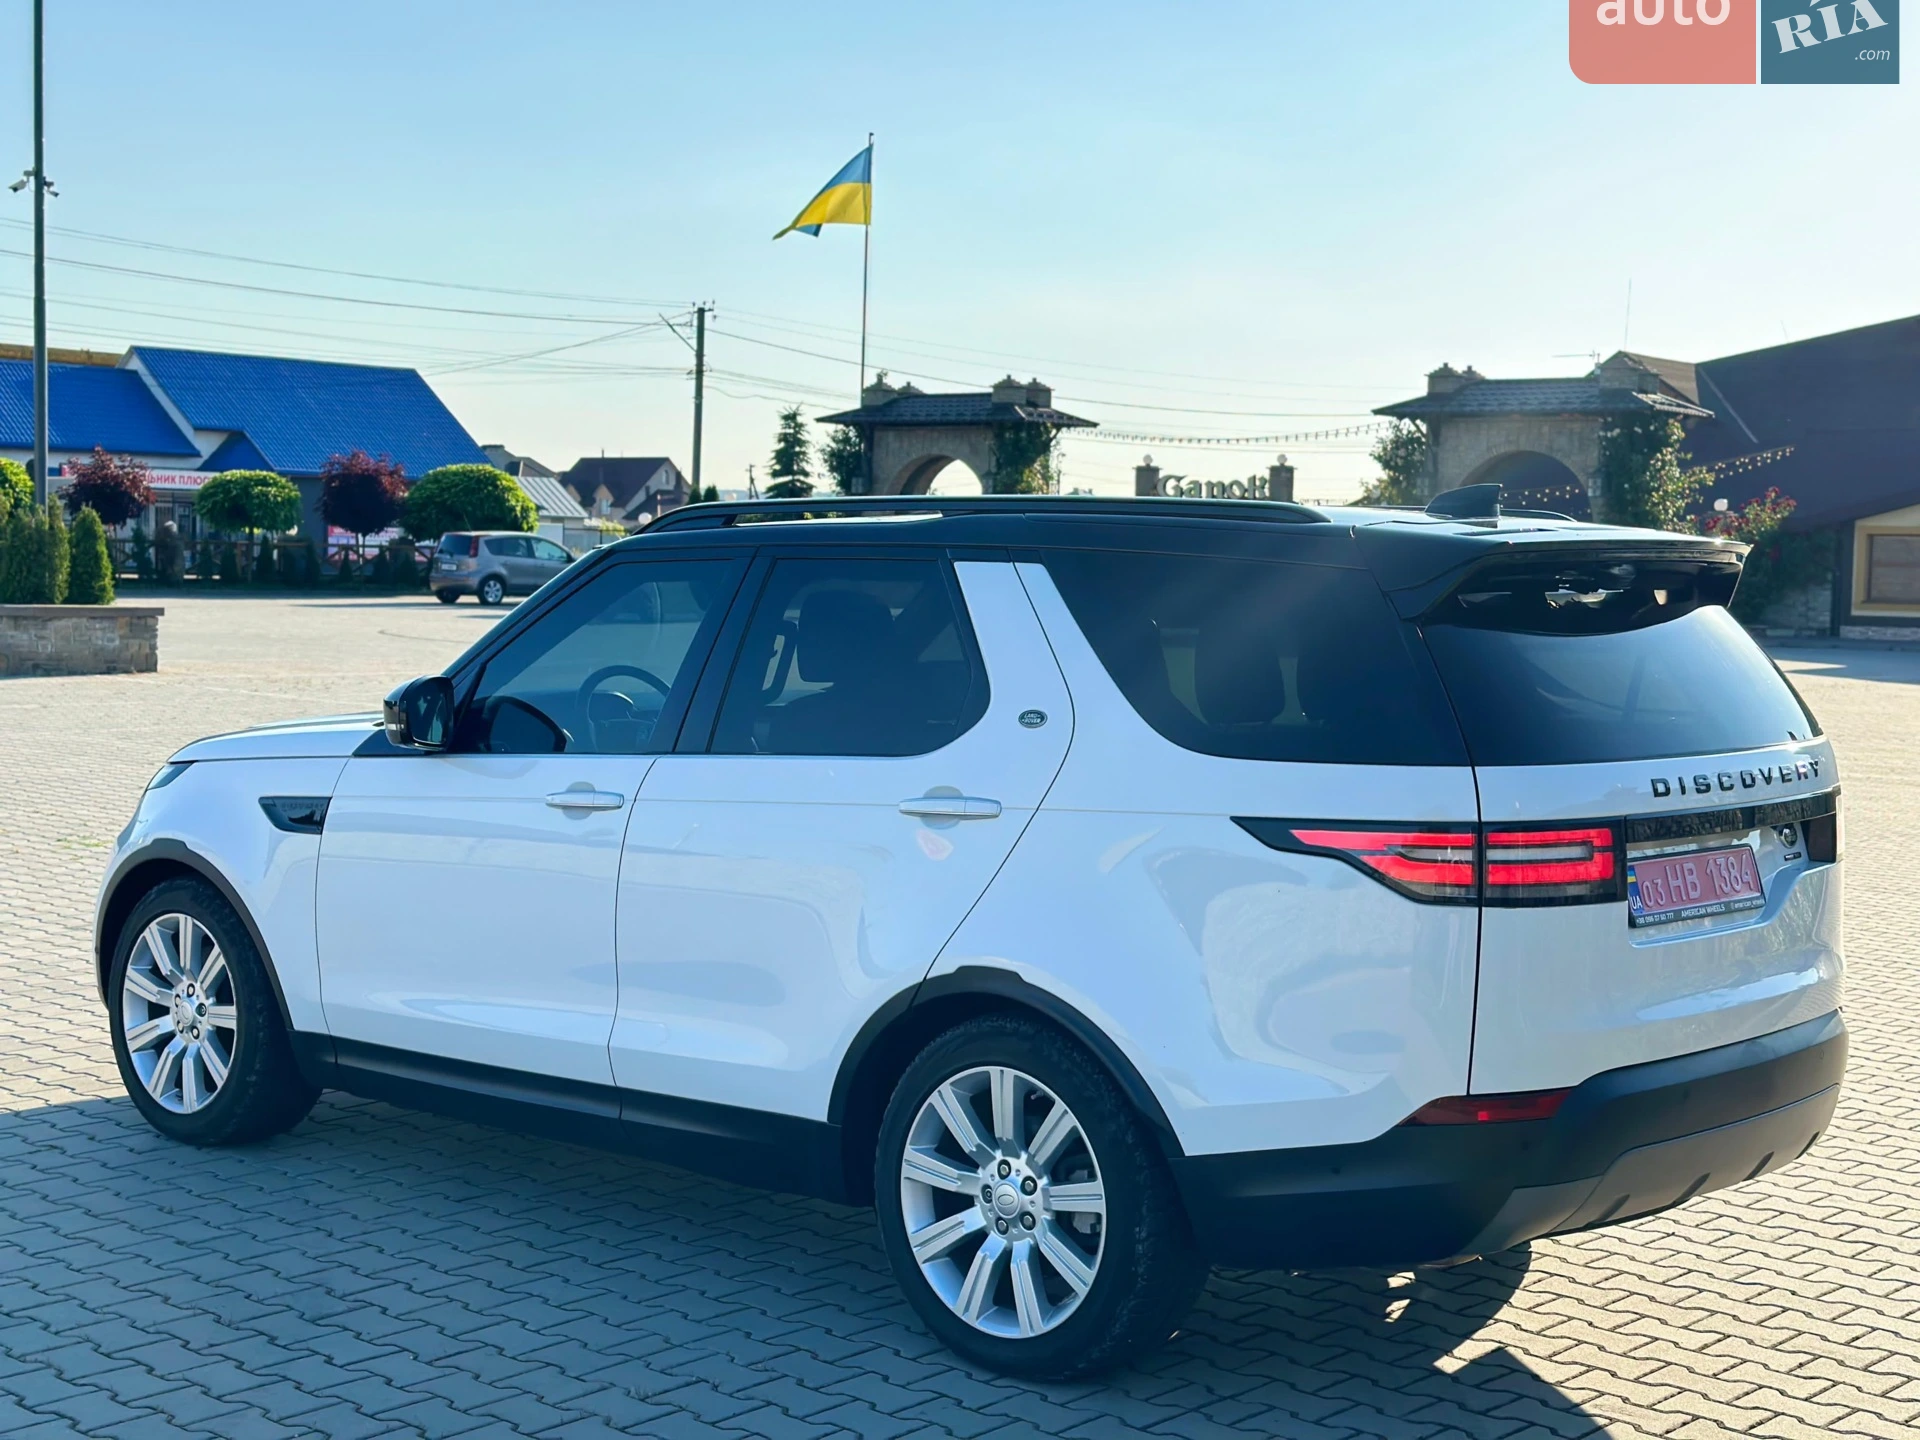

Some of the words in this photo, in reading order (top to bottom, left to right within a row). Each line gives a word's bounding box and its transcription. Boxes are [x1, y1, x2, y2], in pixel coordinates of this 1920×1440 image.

[1651, 760, 1820, 798] DISCOVERY
[1642, 878, 1665, 908] 03
[1706, 853, 1756, 896] 1384
[1631, 895, 1643, 910] UA
[1681, 906, 1706, 918] AMERICAN
[1706, 903, 1726, 914] WHEELS
